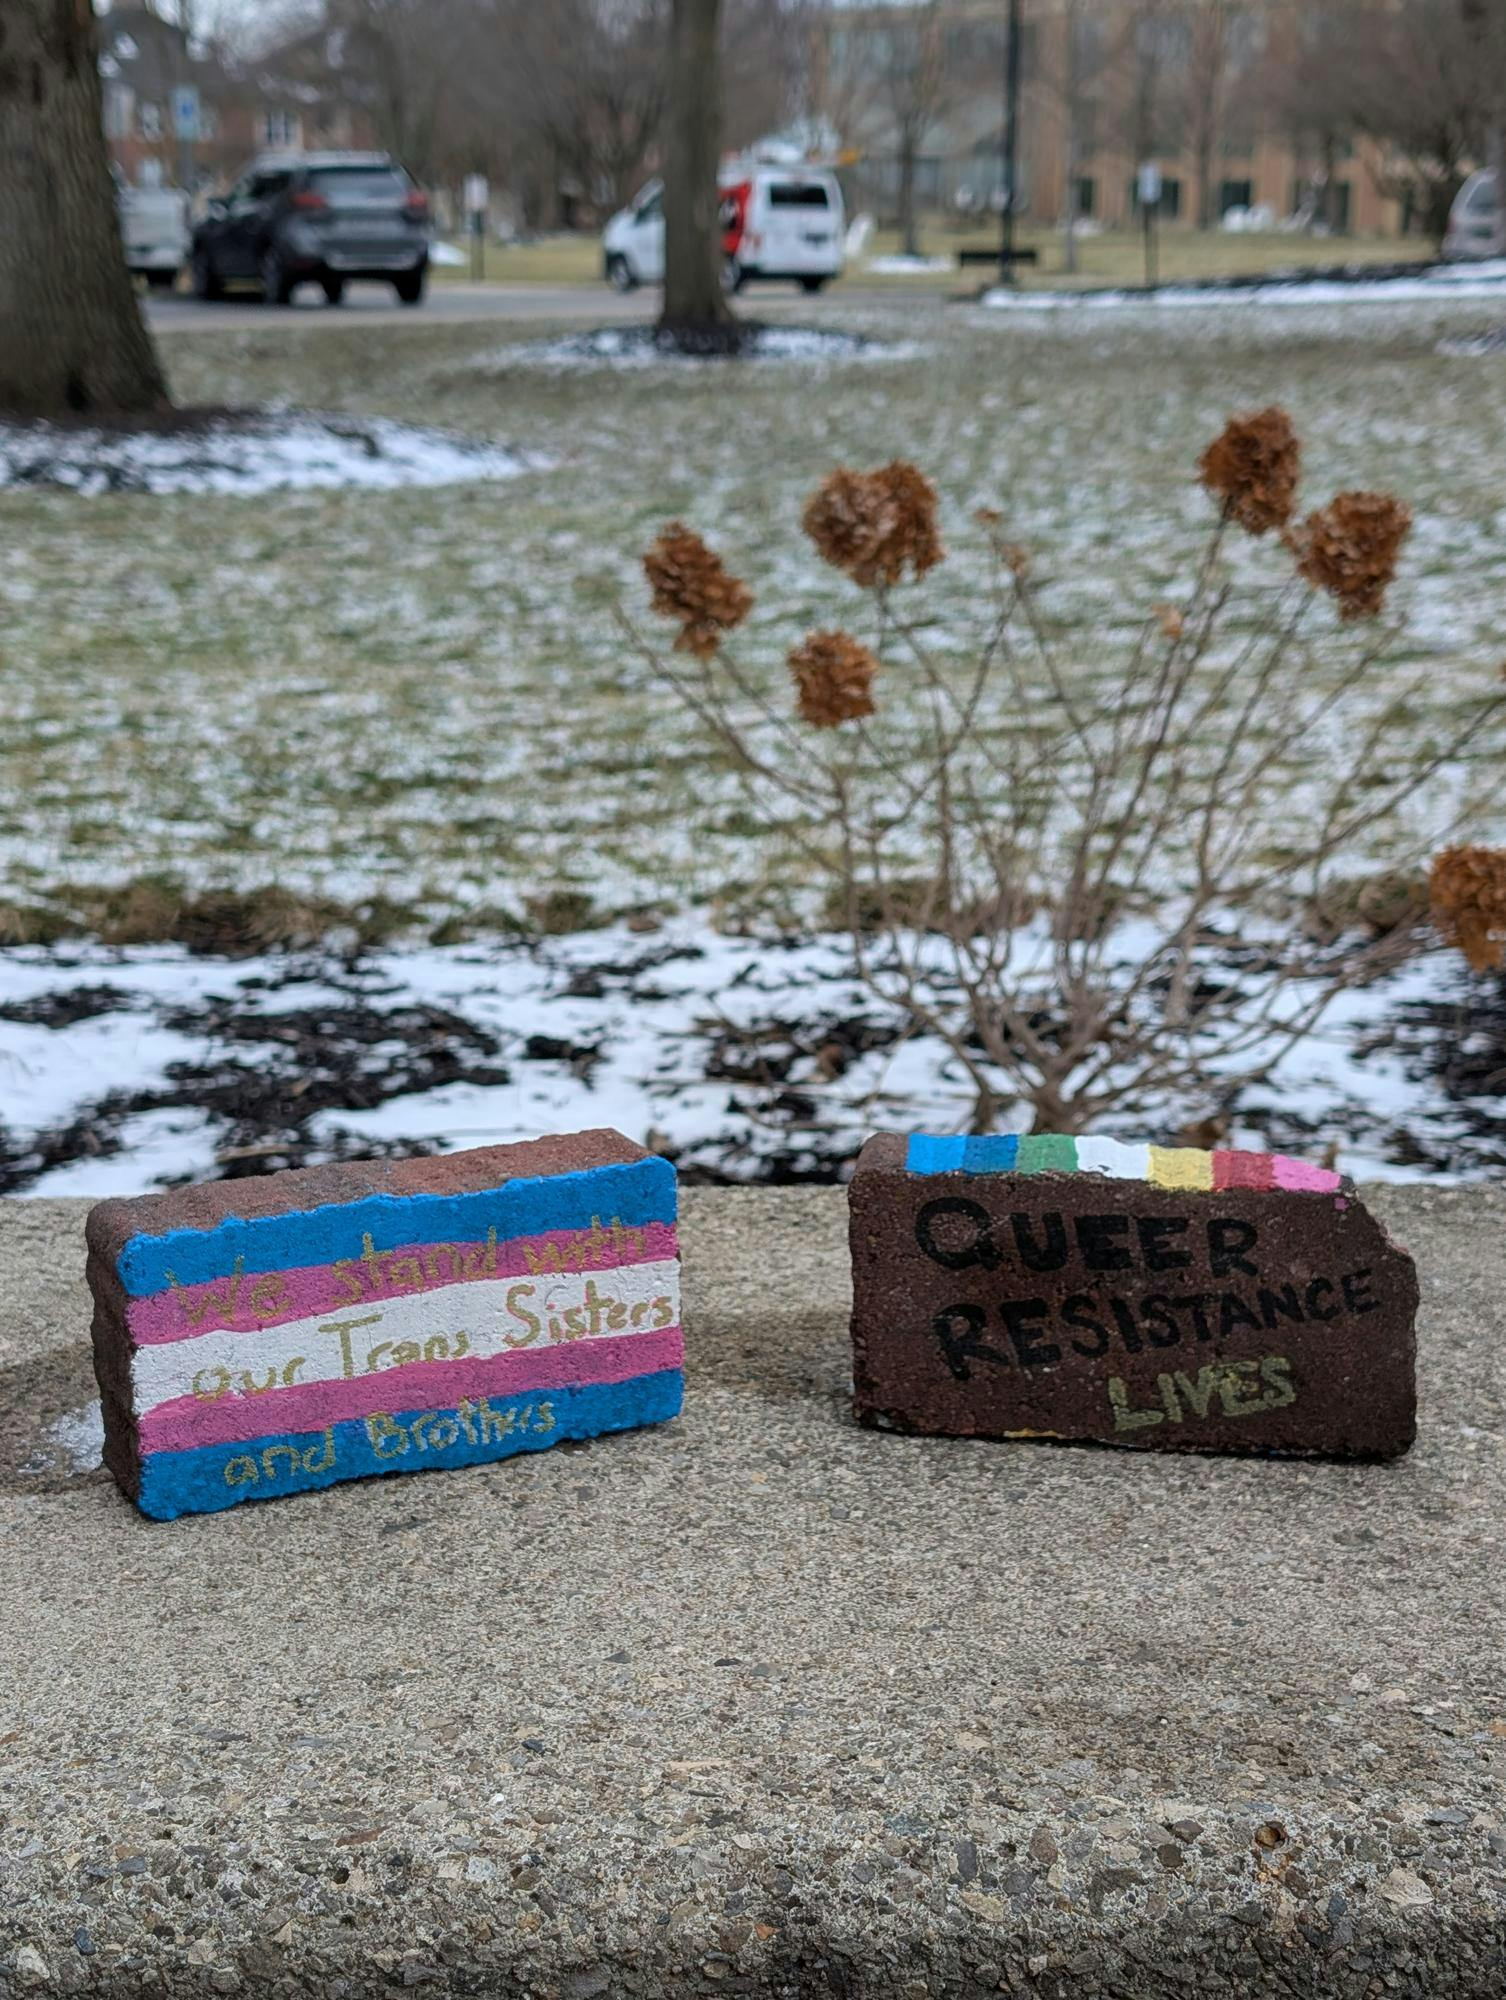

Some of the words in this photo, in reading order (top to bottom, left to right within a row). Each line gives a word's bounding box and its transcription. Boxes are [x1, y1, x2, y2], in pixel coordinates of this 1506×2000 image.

[165, 1255, 293, 1326] We
[331, 1226, 498, 1306] stand
[522, 1214, 646, 1274] with
[915, 1197, 1258, 1276] QUEER
[503, 1281, 673, 1348] Sisters
[932, 1270, 1381, 1379] RESISTANCE
[1107, 1356, 1296, 1431] LIVES
[224, 1427, 335, 1486] and
